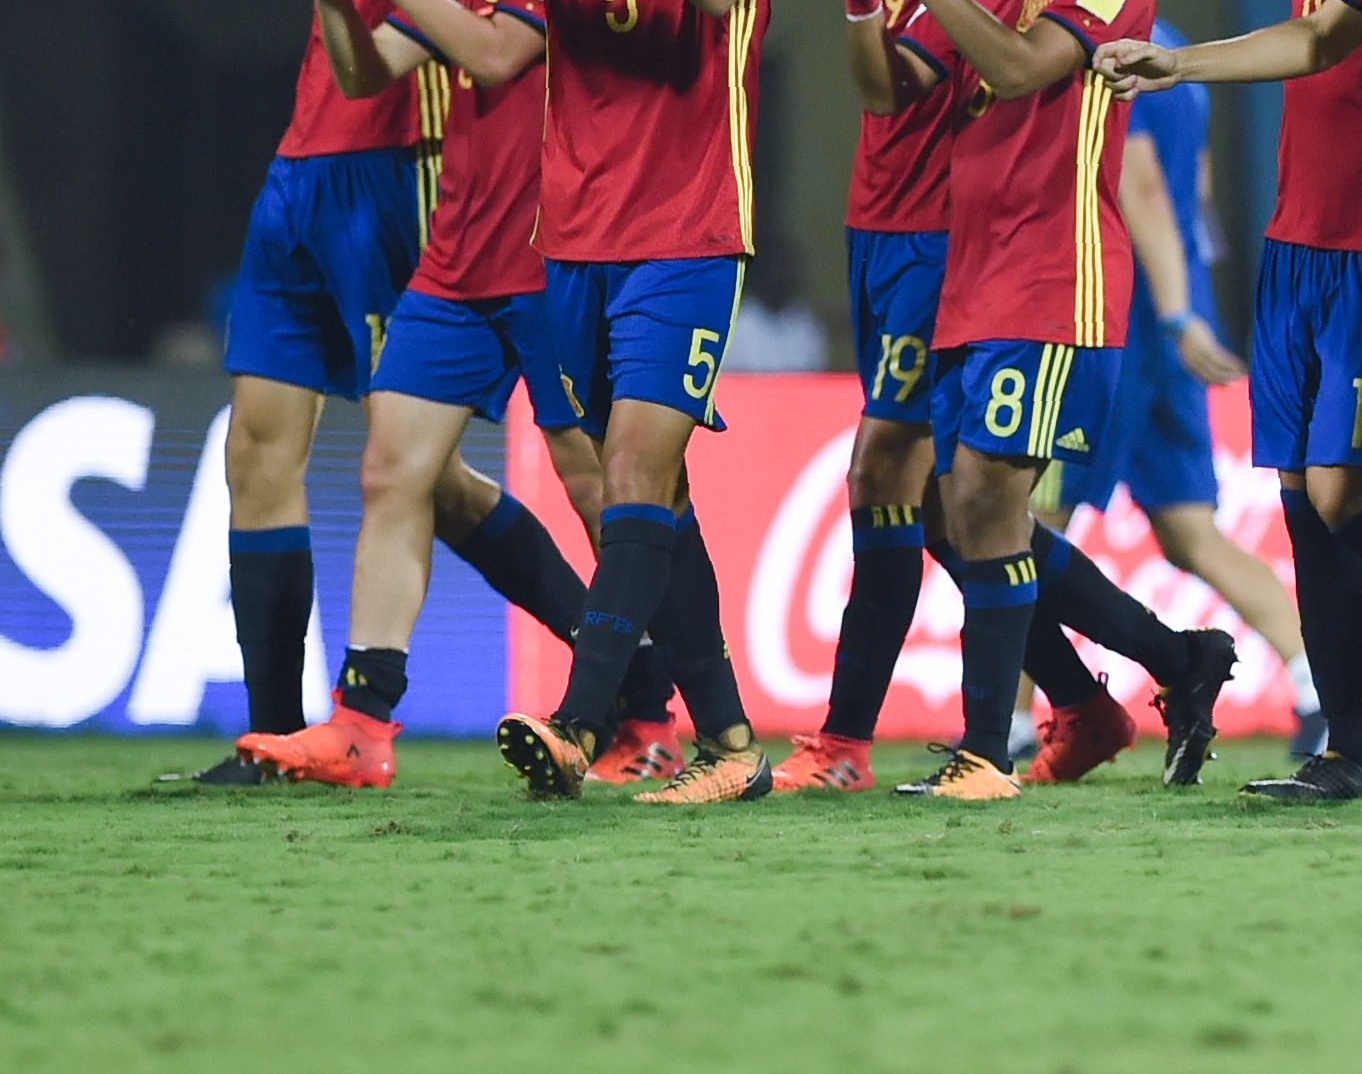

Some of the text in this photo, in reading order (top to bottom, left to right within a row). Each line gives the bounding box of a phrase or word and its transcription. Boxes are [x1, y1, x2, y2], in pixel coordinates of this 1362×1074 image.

[683, 329, 720, 399] 5
[872, 334, 926, 403] 19
[984, 368, 1026, 438] 8
